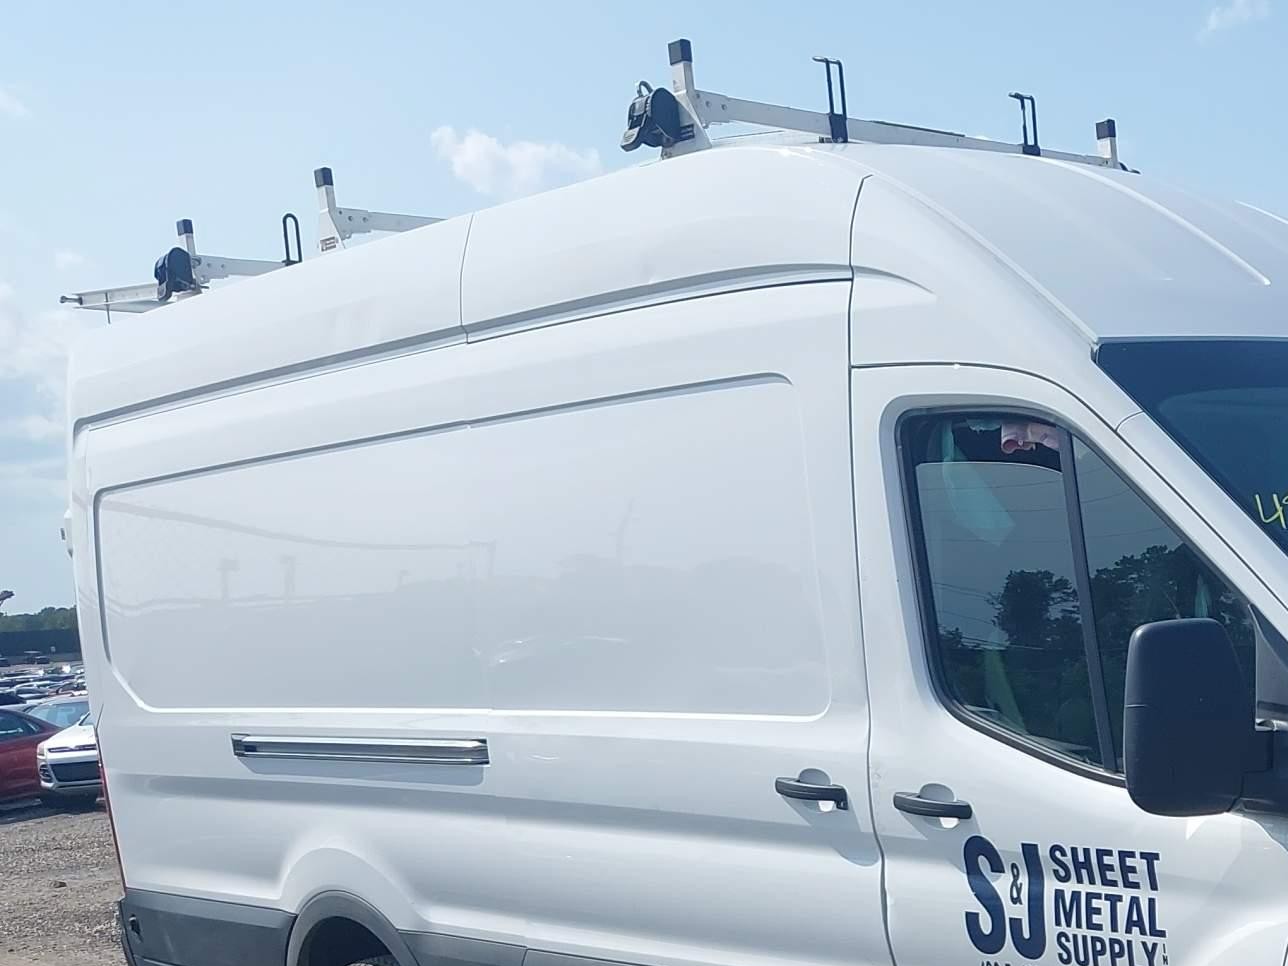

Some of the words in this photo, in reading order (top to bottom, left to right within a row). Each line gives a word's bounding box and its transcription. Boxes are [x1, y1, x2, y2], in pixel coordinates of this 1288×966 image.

[1049, 844, 1160, 892] SHEET
[964, 835, 1047, 960] S&J
[1054, 889, 1167, 939] METAL
